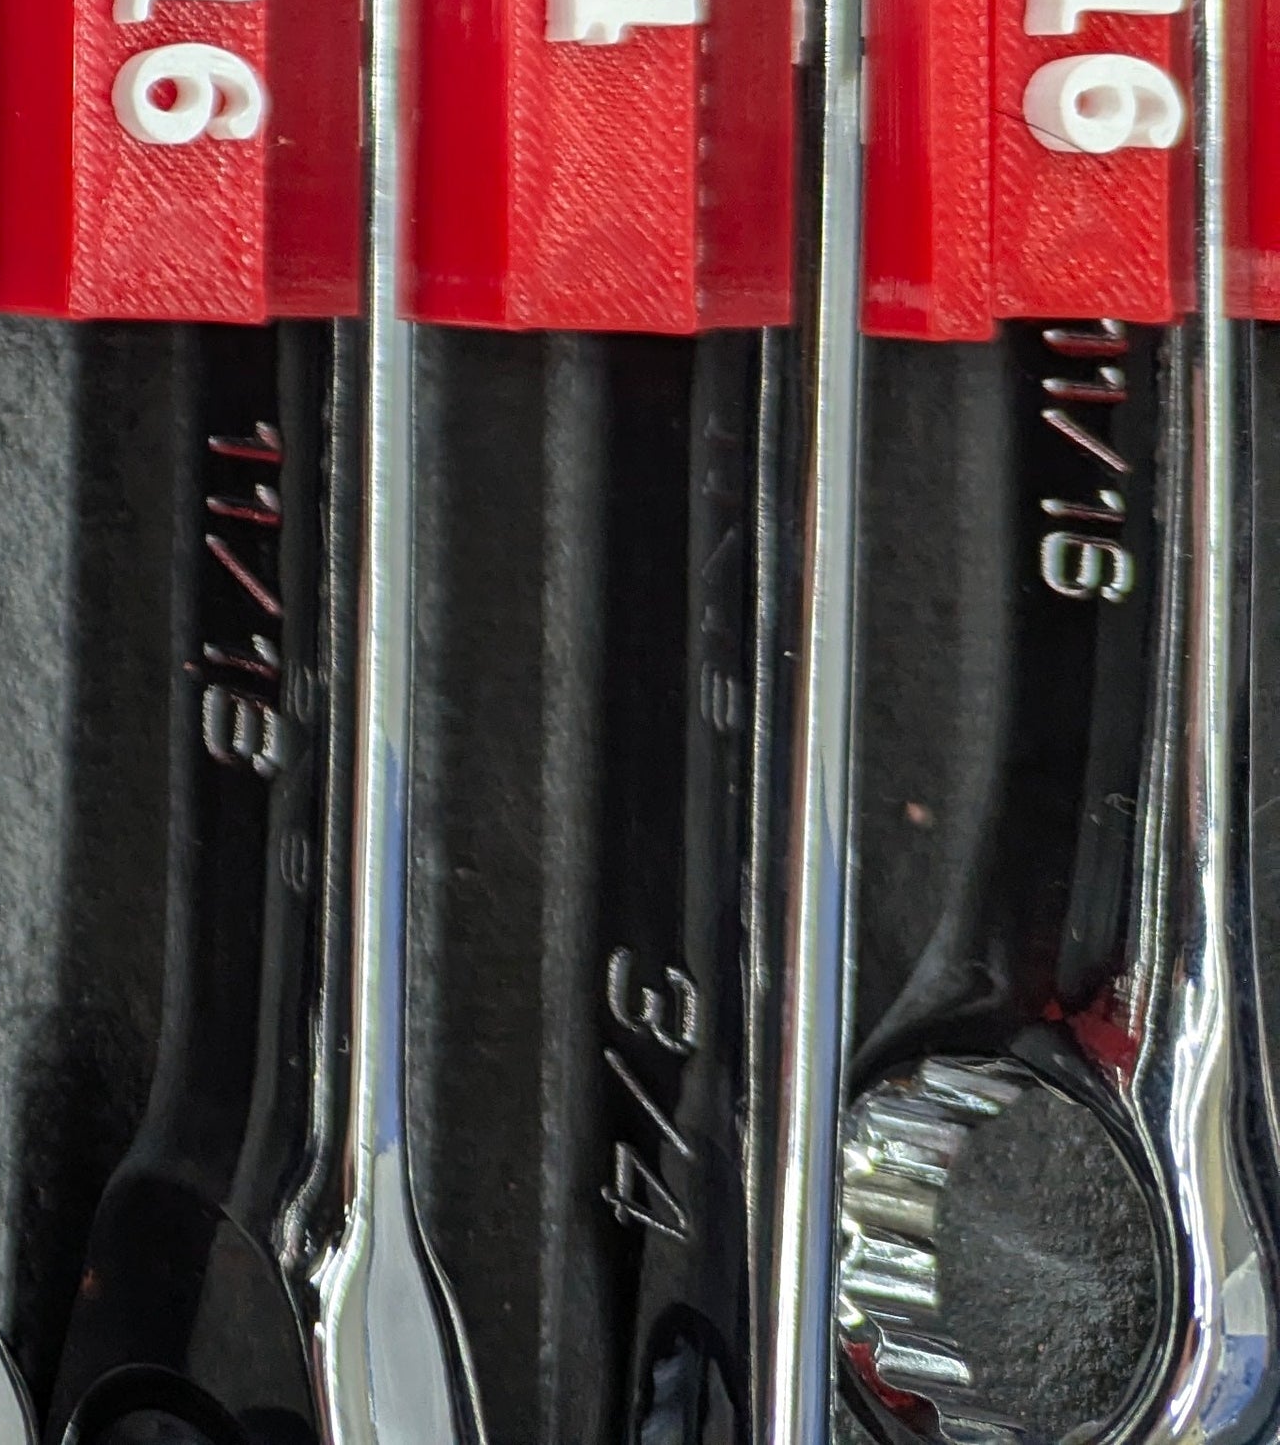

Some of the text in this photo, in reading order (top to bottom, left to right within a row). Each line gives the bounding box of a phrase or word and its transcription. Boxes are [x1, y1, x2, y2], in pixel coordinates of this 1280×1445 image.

[201, 419, 285, 779] 11/16
[1040, 317, 1134, 603] 11/16
[600, 943, 702, 1244] 3/4
